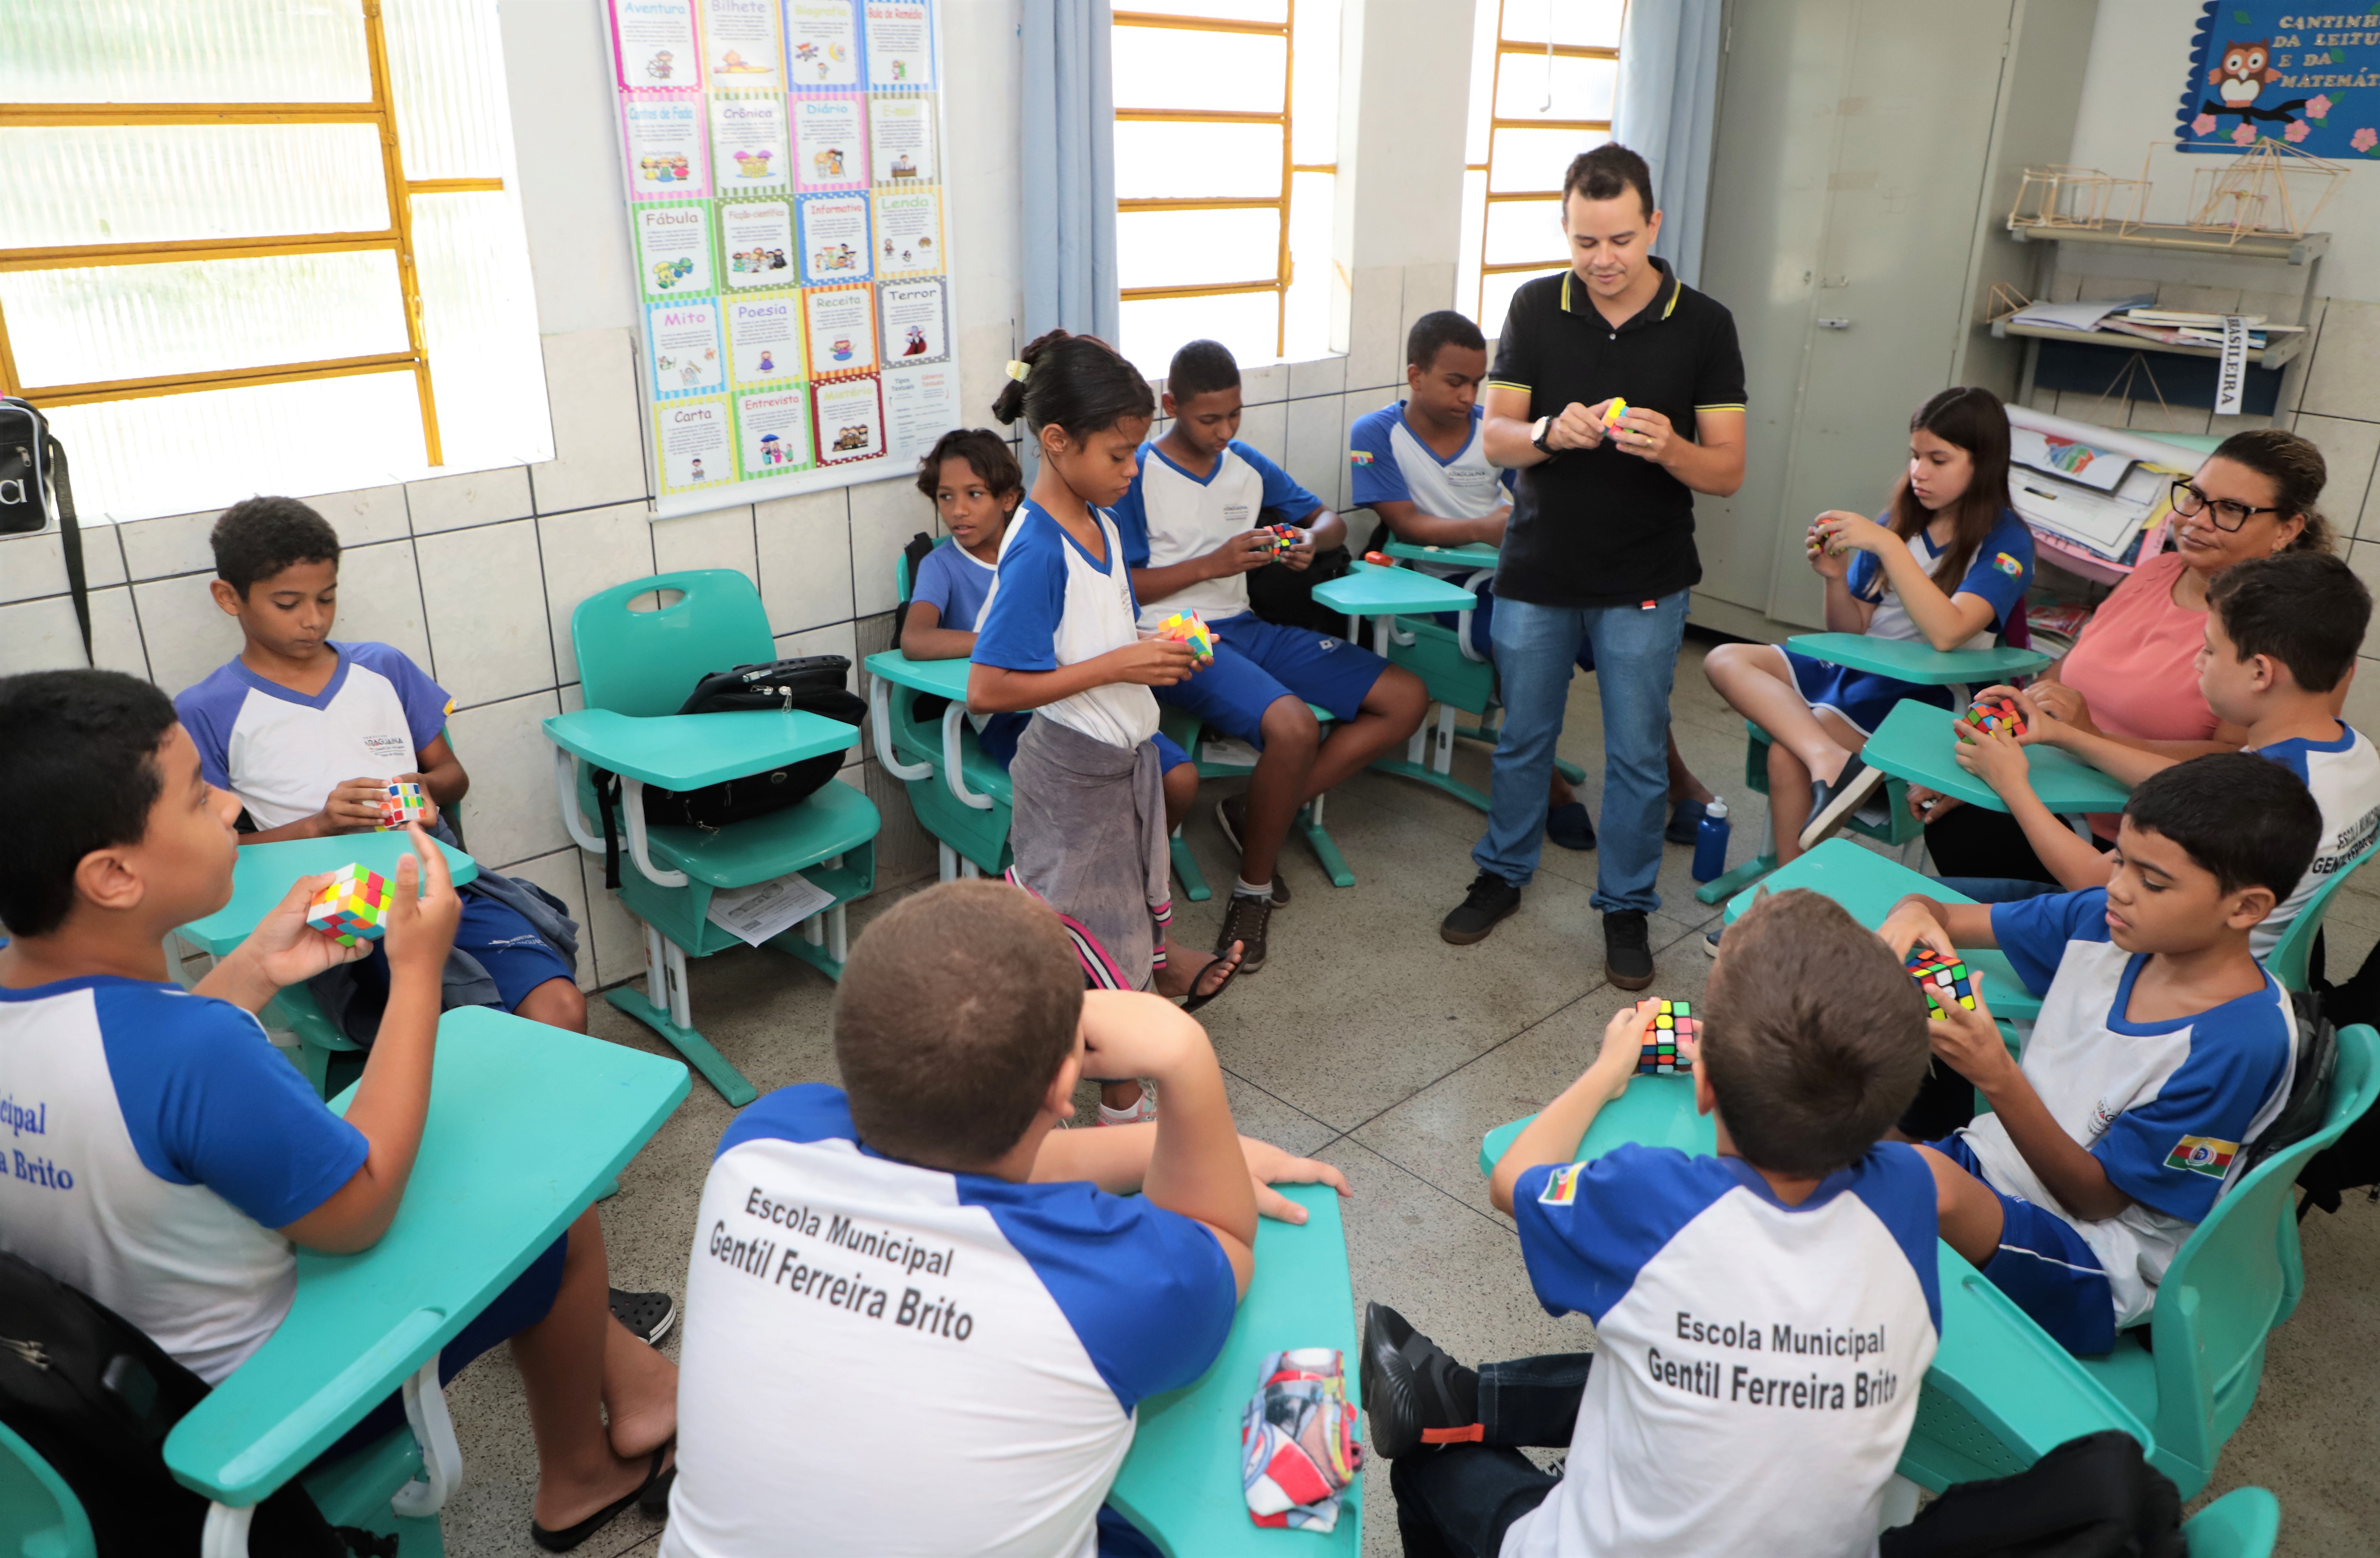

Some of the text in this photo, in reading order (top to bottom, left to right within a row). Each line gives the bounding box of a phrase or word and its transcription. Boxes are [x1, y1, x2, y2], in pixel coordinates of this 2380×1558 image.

[624, 2, 686, 14] Aventura
[712, 0, 766, 12] Bilhete
[885, 8, 893, 18] de
[2279, 15, 2380, 30] CANTINH
[2272, 32, 2380, 48] DA LEITU
[2278, 52, 2333, 67] E DA
[2279, 67, 2380, 88] MATEMÁT
[660, 106, 670, 119] de
[724, 108, 772, 118] Crônica
[807, 103, 848, 114] Diário
[811, 204, 862, 215] Informativo
[882, 196, 929, 209] Lenda
[646, 212, 698, 226] Fábula
[817, 295, 861, 308] Receita
[889, 290, 937, 300] Terror
[739, 304, 787, 318] Poesia
[665, 312, 705, 326] Mito
[824, 386, 873, 400] Mistério
[745, 396, 799, 410] Entrevista
[675, 410, 712, 423] Carta
[0, 1093, 45, 1137] cipal
[13, 1148, 73, 1190] Brito
[745, 1186, 955, 1276] Escola Municipal
[710, 1220, 974, 1341] Gentil Ferreira Brito
[1677, 1311, 1885, 1362] Escola Municipal
[1648, 1346, 1897, 1410] Gentil Ferreira Brito
